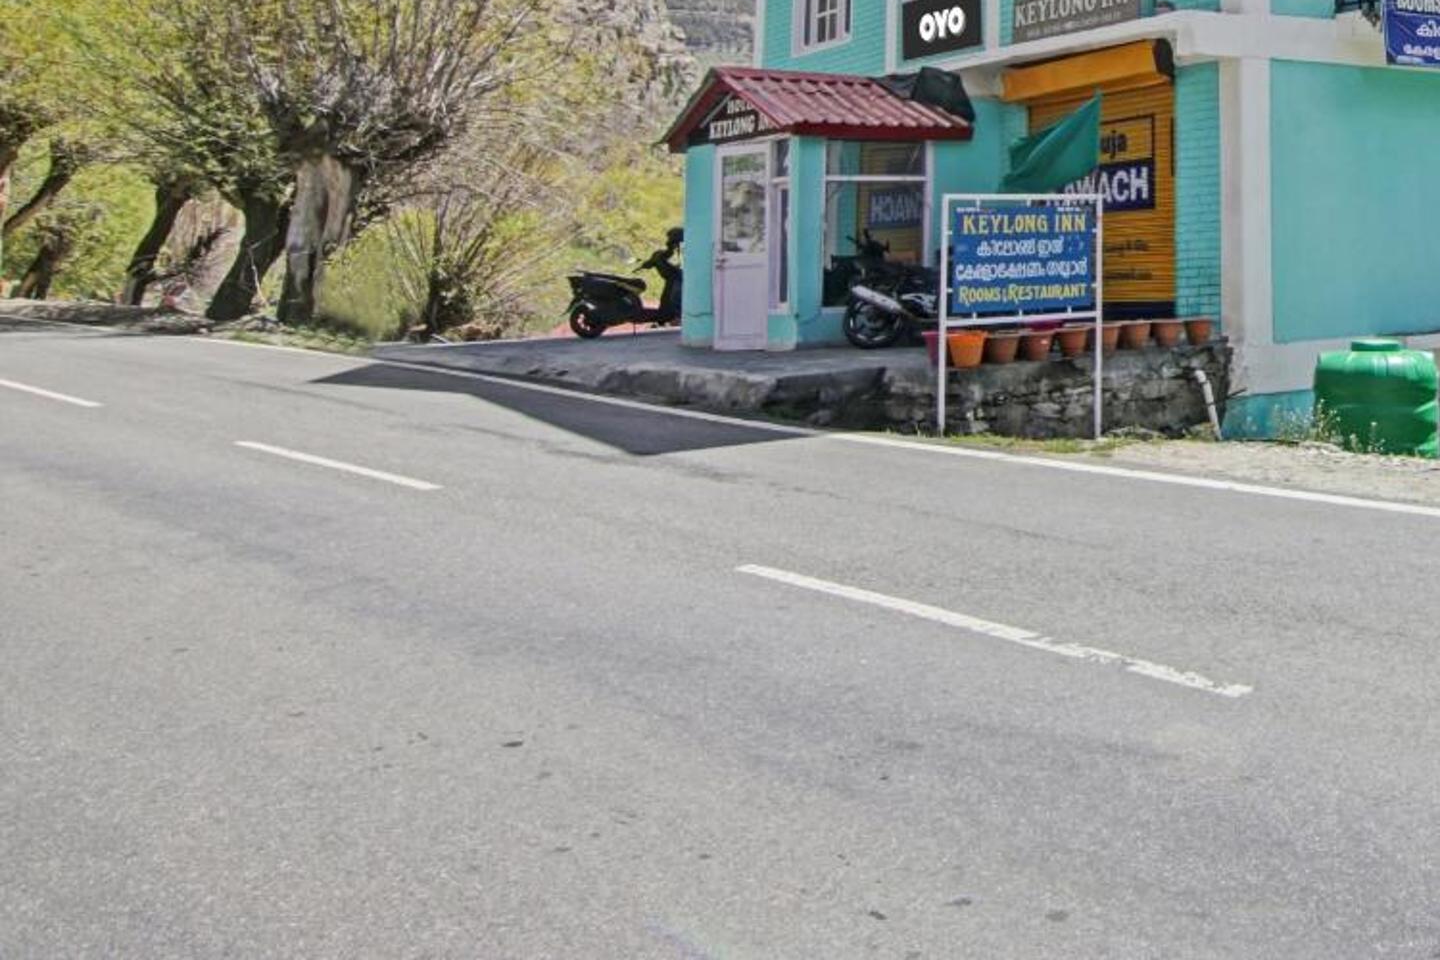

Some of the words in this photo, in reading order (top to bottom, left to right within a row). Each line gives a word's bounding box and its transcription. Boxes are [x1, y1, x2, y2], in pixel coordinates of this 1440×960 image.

[919, 6, 966, 41] OYO
[962, 214, 1048, 235] KEYLONG
[1055, 213, 1086, 233] INN
